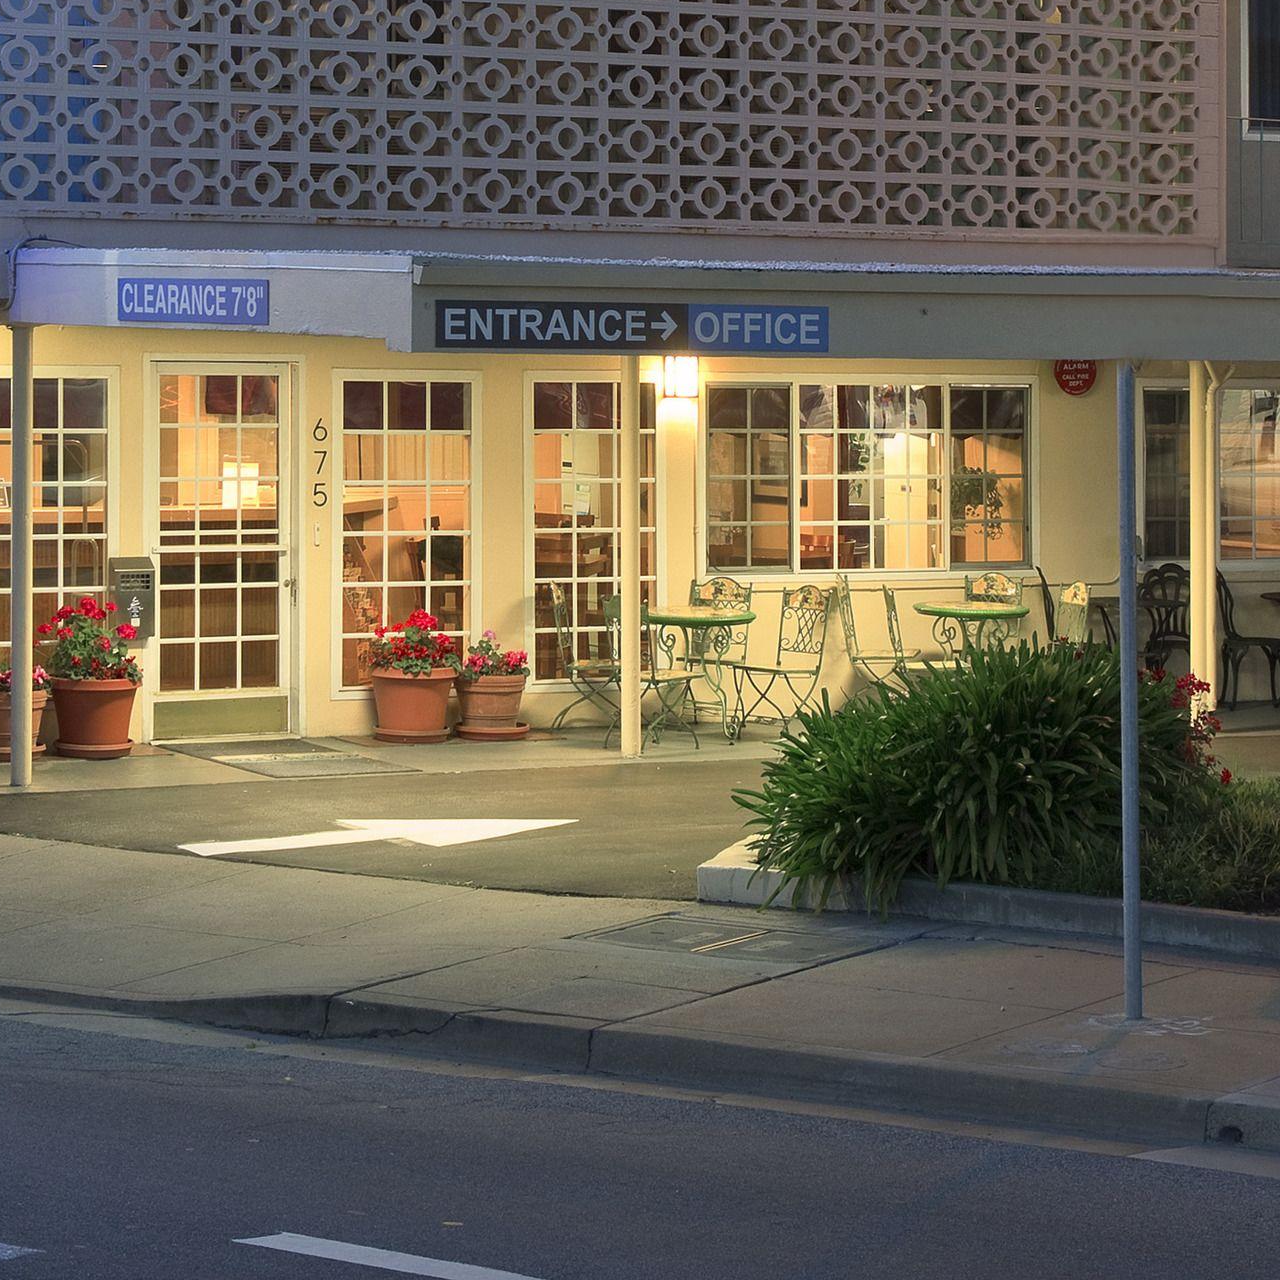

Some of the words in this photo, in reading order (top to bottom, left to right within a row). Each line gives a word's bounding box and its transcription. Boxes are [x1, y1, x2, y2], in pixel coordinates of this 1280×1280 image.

[121, 282, 227, 317] CLEARANCE
[231, 285, 265, 318] 7'8"
[443, 306, 647, 343] ENTRANCE
[694, 309, 821, 345] OFFICE
[313, 417, 328, 507] 675
